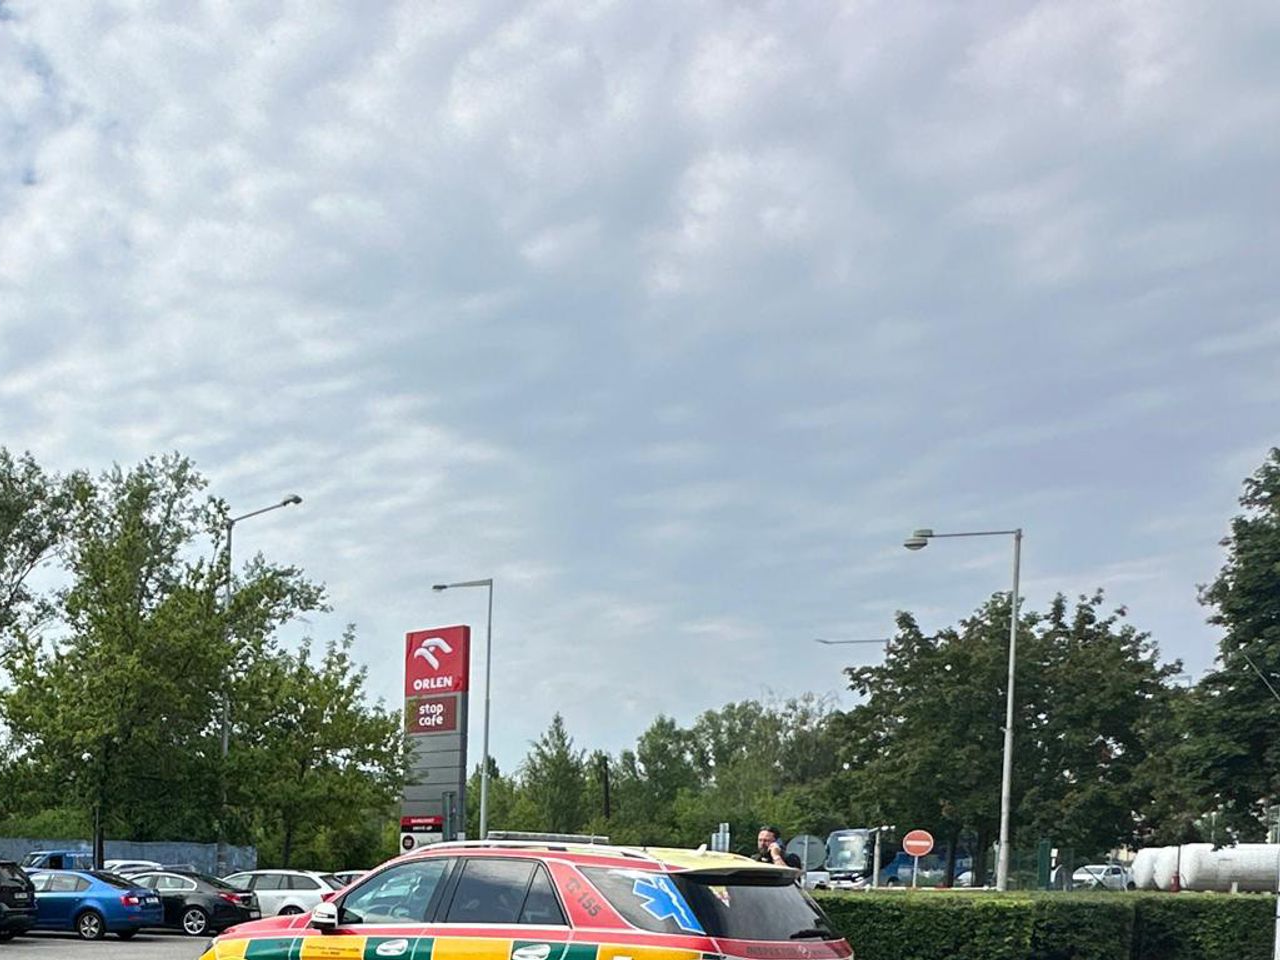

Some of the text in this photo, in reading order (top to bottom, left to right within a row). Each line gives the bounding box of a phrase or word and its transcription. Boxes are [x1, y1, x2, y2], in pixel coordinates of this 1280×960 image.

[413, 676, 453, 690] ORLEN
[419, 703, 444, 715] stop
[418, 715, 444, 727] cafe
